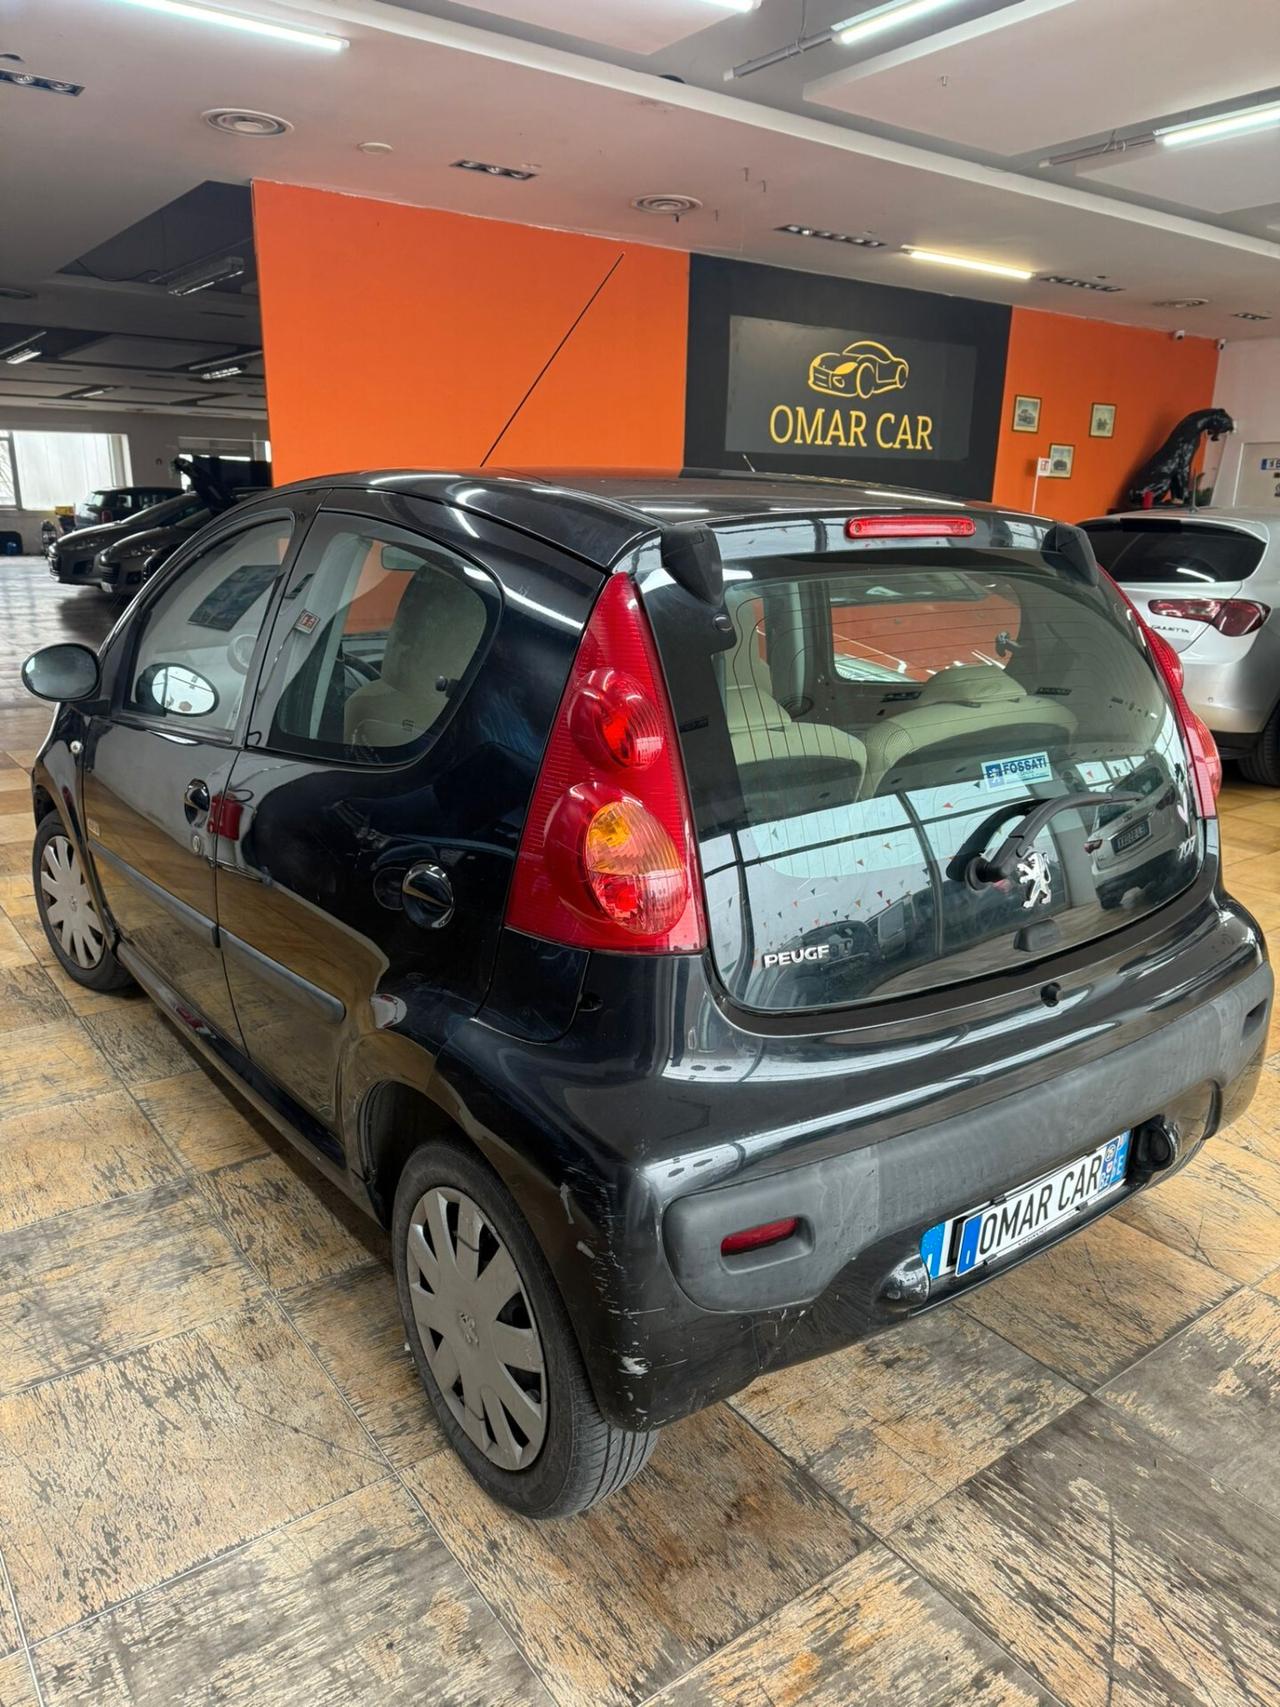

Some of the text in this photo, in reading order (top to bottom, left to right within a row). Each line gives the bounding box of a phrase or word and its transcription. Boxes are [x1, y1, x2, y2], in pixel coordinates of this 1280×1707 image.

[769, 404, 934, 451] OMAR CAR
[1002, 757, 1047, 775] FOSSATI
[979, 1183, 1053, 1255] OMAR
[1057, 1154, 1103, 1211] CAR
